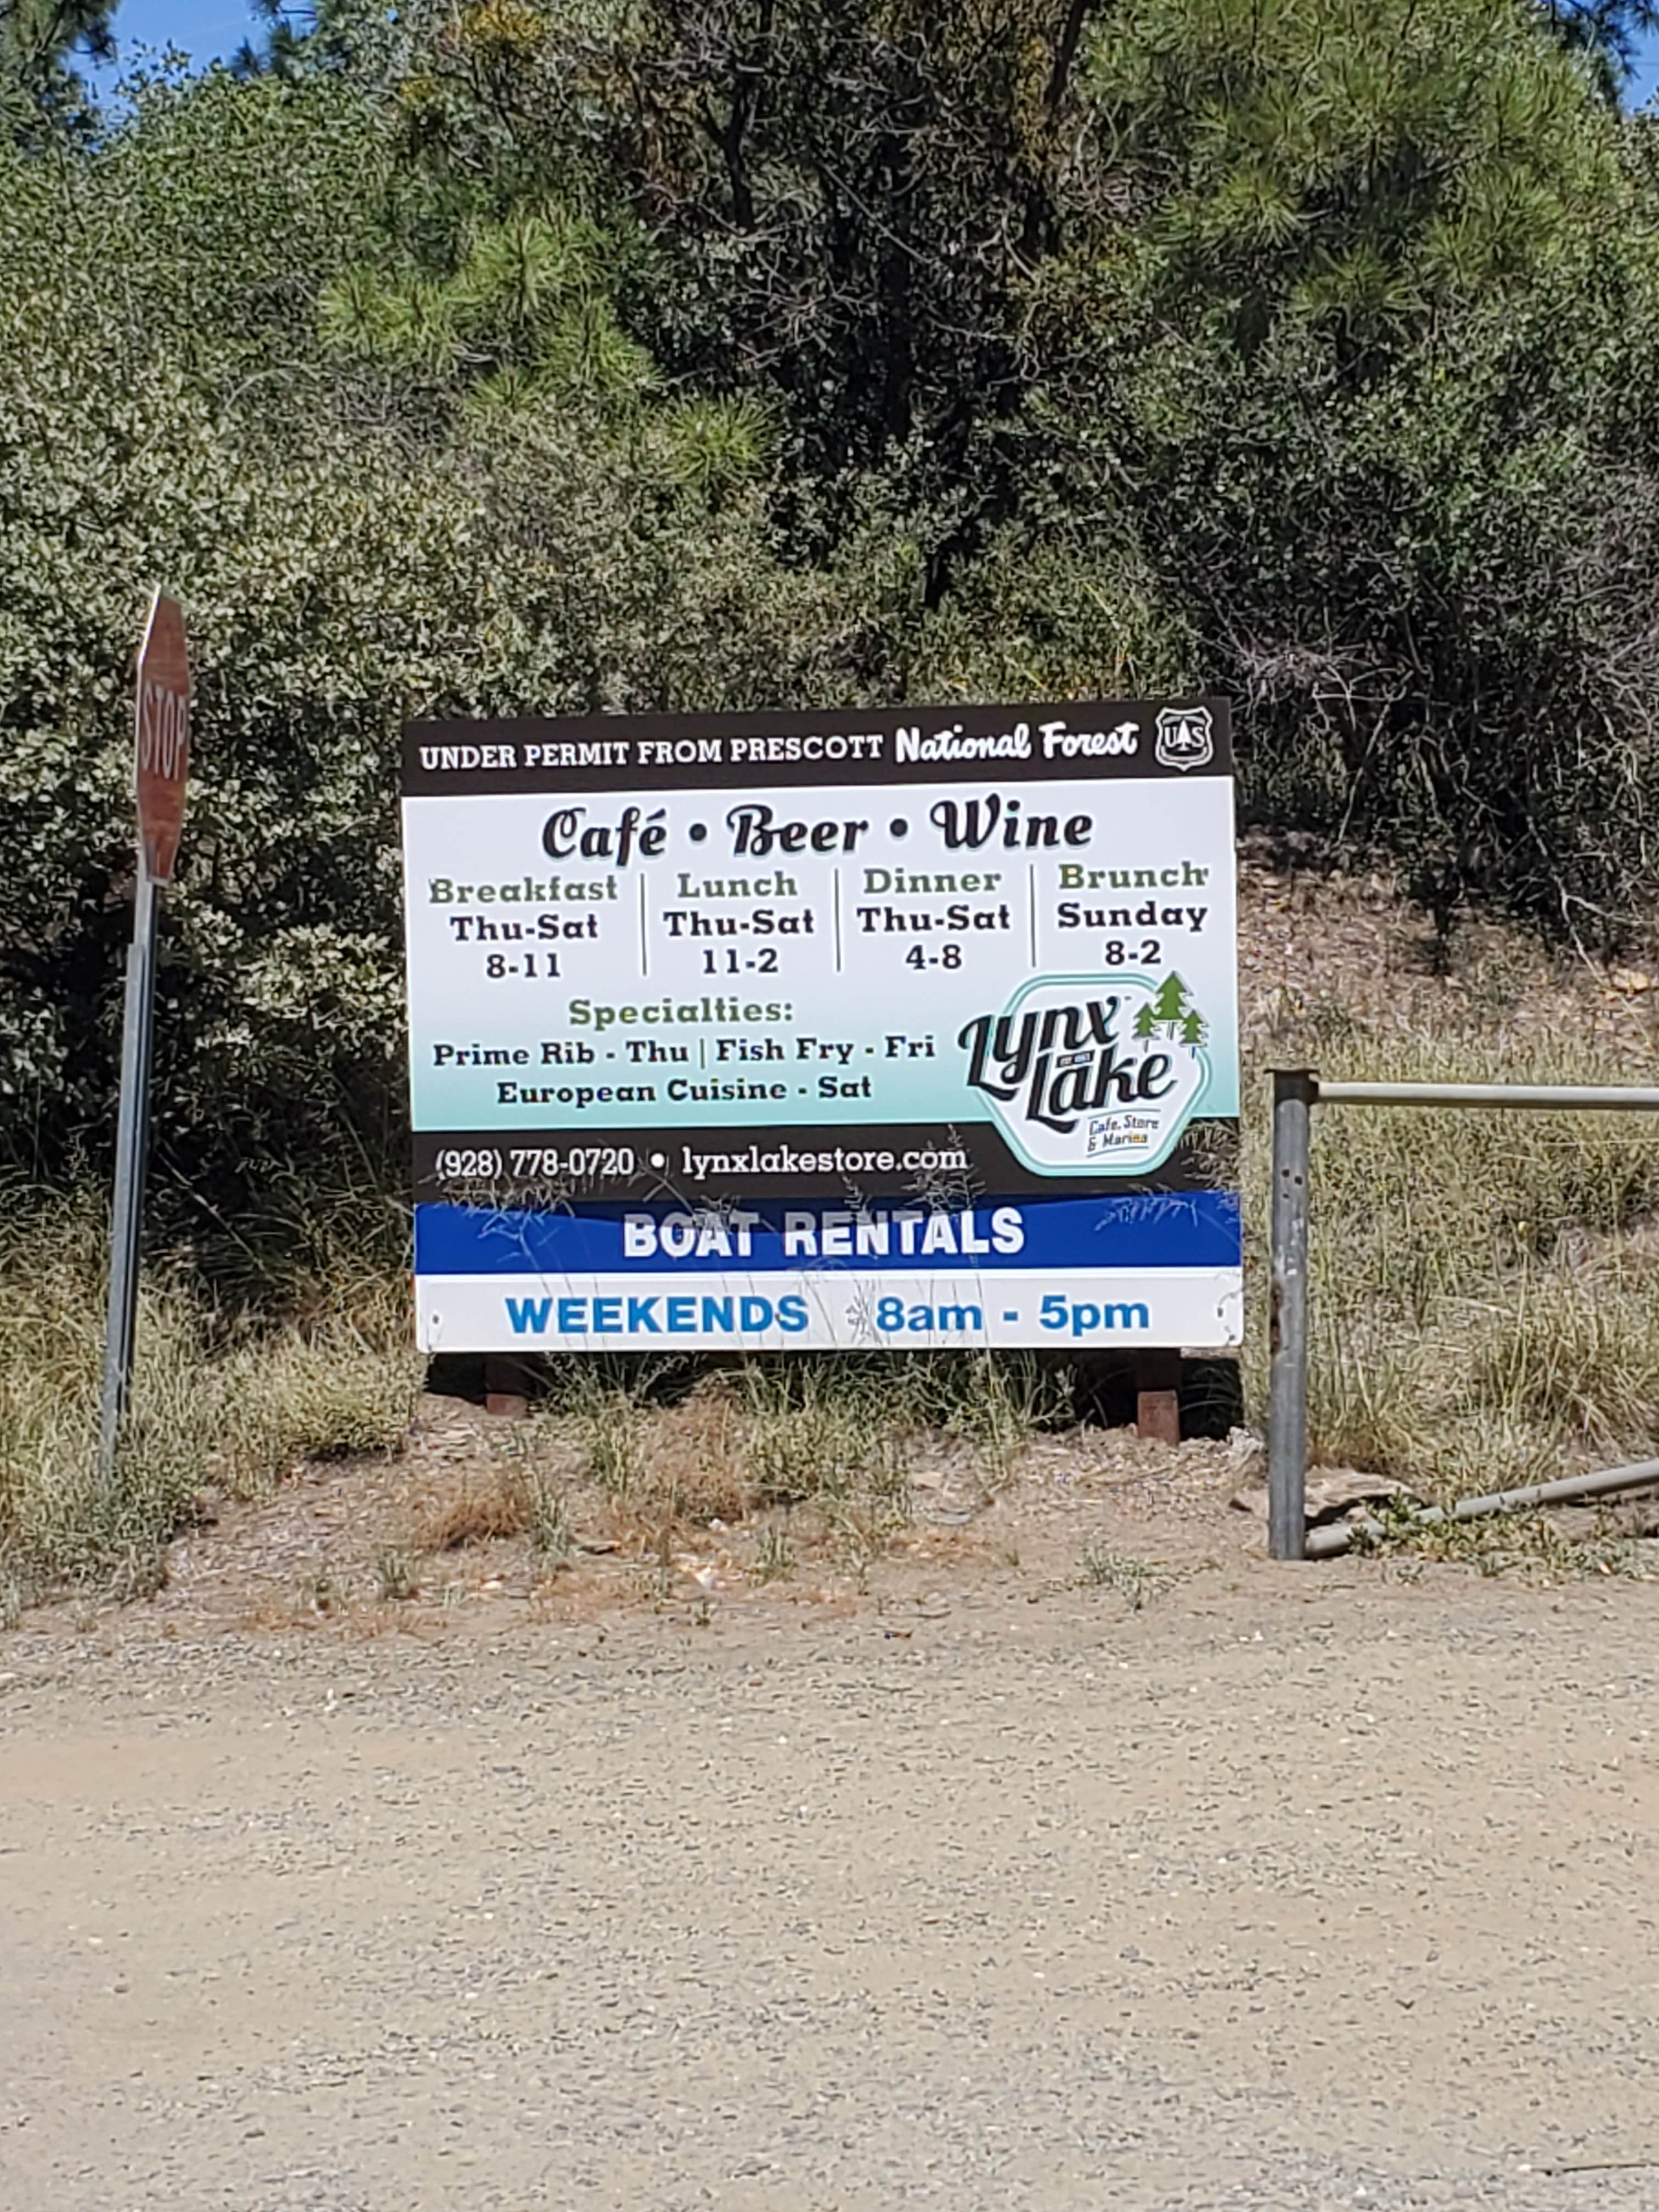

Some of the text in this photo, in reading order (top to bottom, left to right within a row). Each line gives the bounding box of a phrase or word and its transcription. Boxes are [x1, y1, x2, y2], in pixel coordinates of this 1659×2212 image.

[140, 680, 186, 781] STOP
[420, 747, 516, 770] UNDER
[524, 743, 629, 766] PERMIT
[638, 740, 721, 765] FROM
[731, 734, 883, 763] PRESCOTT
[895, 724, 1031, 763] National
[1040, 721, 1139, 759] Forest
[542, 793, 1093, 867] Café Beer Wine
[429, 875, 617, 904] Breakfast
[678, 871, 798, 899] Lunch
[864, 867, 1001, 894] Dinner
[1059, 861, 1209, 889] Brunch
[450, 913, 598, 941] Thu-Sat
[663, 909, 814, 937] Thu-Sat
[857, 905, 1010, 933] Thu-Sat
[1058, 901, 1208, 932] Sunday
[486, 954, 561, 979] 8-11
[703, 949, 778, 974] 11-2
[906, 945, 962, 969] 4-8
[1105, 941, 1161, 966] 8-2
[569, 997, 793, 1031] Specialties:
[433, 1043, 529, 1066] Prime
[541, 1042, 595, 1064] Rib
[627, 1040, 689, 1063] Thu
[716, 1038, 785, 1062] Fish
[797, 1038, 854, 1064] Fry
[885, 1035, 935, 1057] Fri
[958, 996, 1120, 1102] Lynx
[497, 1082, 656, 1108] European
[668, 1079, 787, 1103] Cuisine
[819, 1076, 871, 1098] Sat
[1026, 1043, 1177, 1135] Lake
[1124, 1115, 1159, 1129] Store
[1102, 1132, 1148, 1148] Marina
[435, 1148, 635, 1180] (928) 778-0720
[682, 1145, 968, 1180] lynxlakestore.com
[624, 1206, 1025, 1257] BOAT RENTALS
[505, 1296, 809, 1333] WEEKENDS
[877, 1296, 982, 1331] 8am
[1040, 1295, 1149, 1337] 5pm
